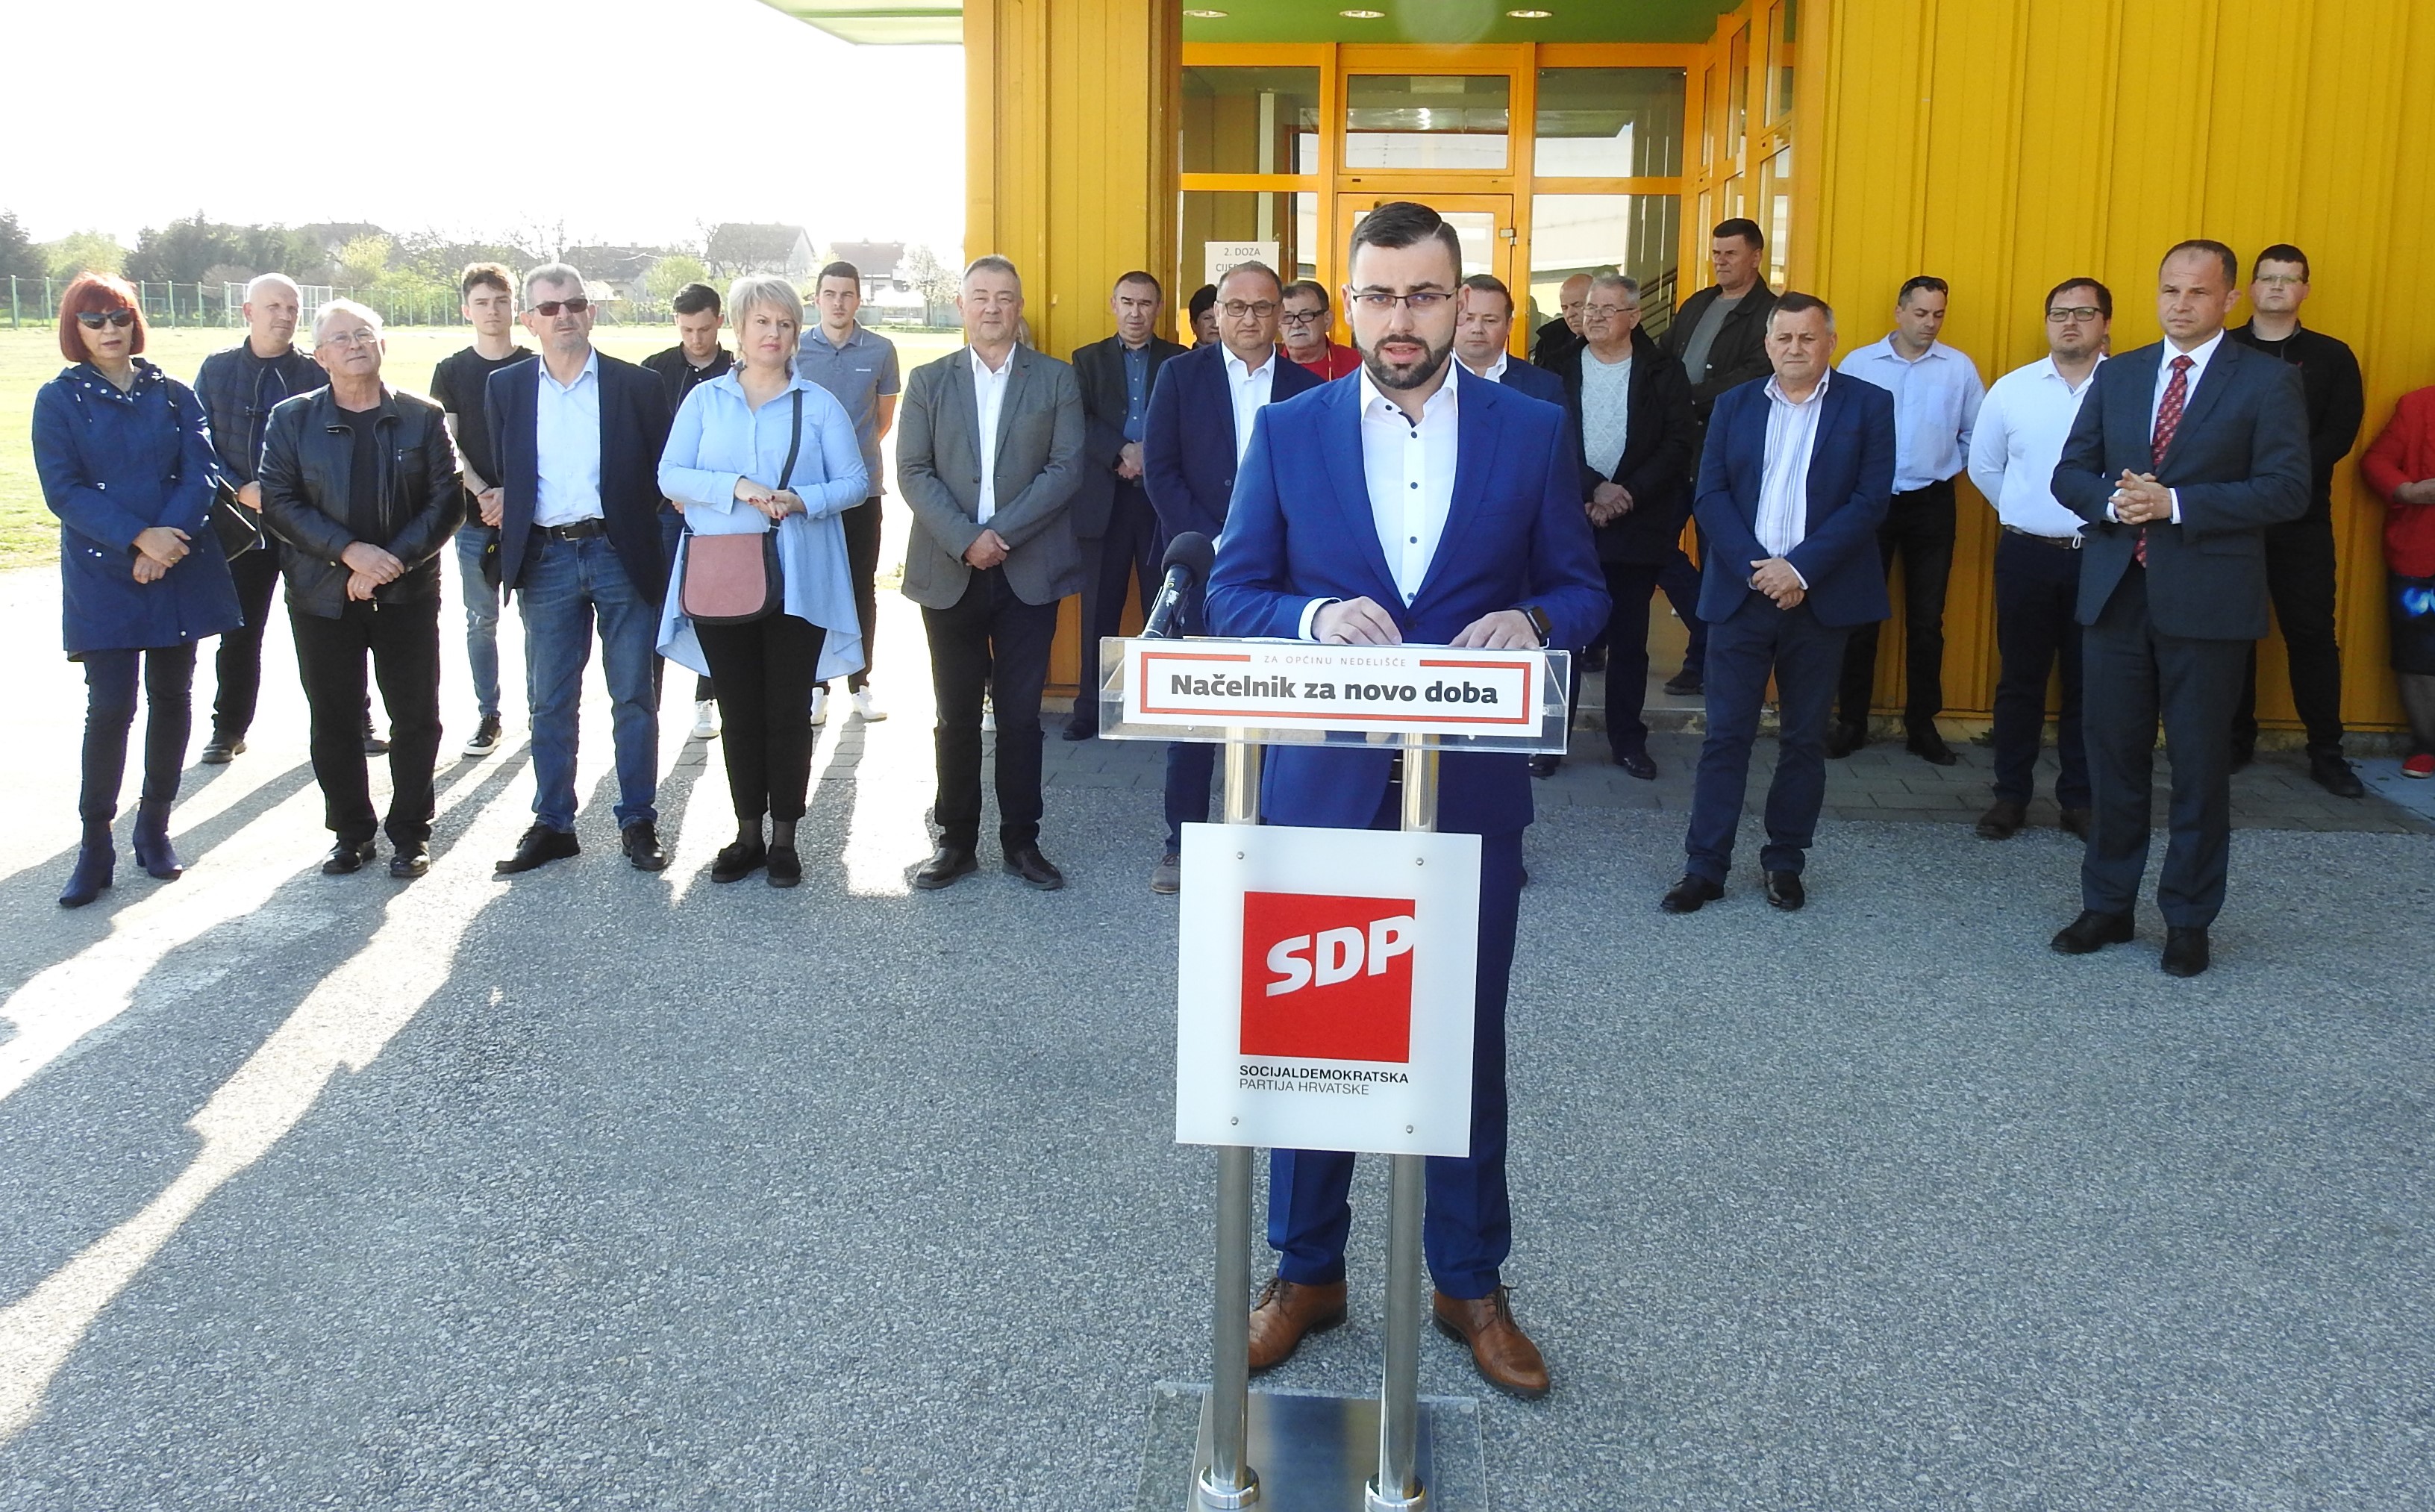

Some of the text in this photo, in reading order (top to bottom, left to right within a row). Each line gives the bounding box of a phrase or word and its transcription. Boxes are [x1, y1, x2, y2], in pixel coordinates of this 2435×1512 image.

[1224, 248, 1260, 256] 2. DOZA
[1264, 655, 1278, 663] ZA
[1172, 673, 1498, 704] Načelnik za novo doba
[1266, 915, 1415, 997] SDP
[1240, 1065, 1409, 1084] SOCIJALDEMOKRATSKA
[1240, 1078, 1369, 1096] PARTIJA HRVATSKE
